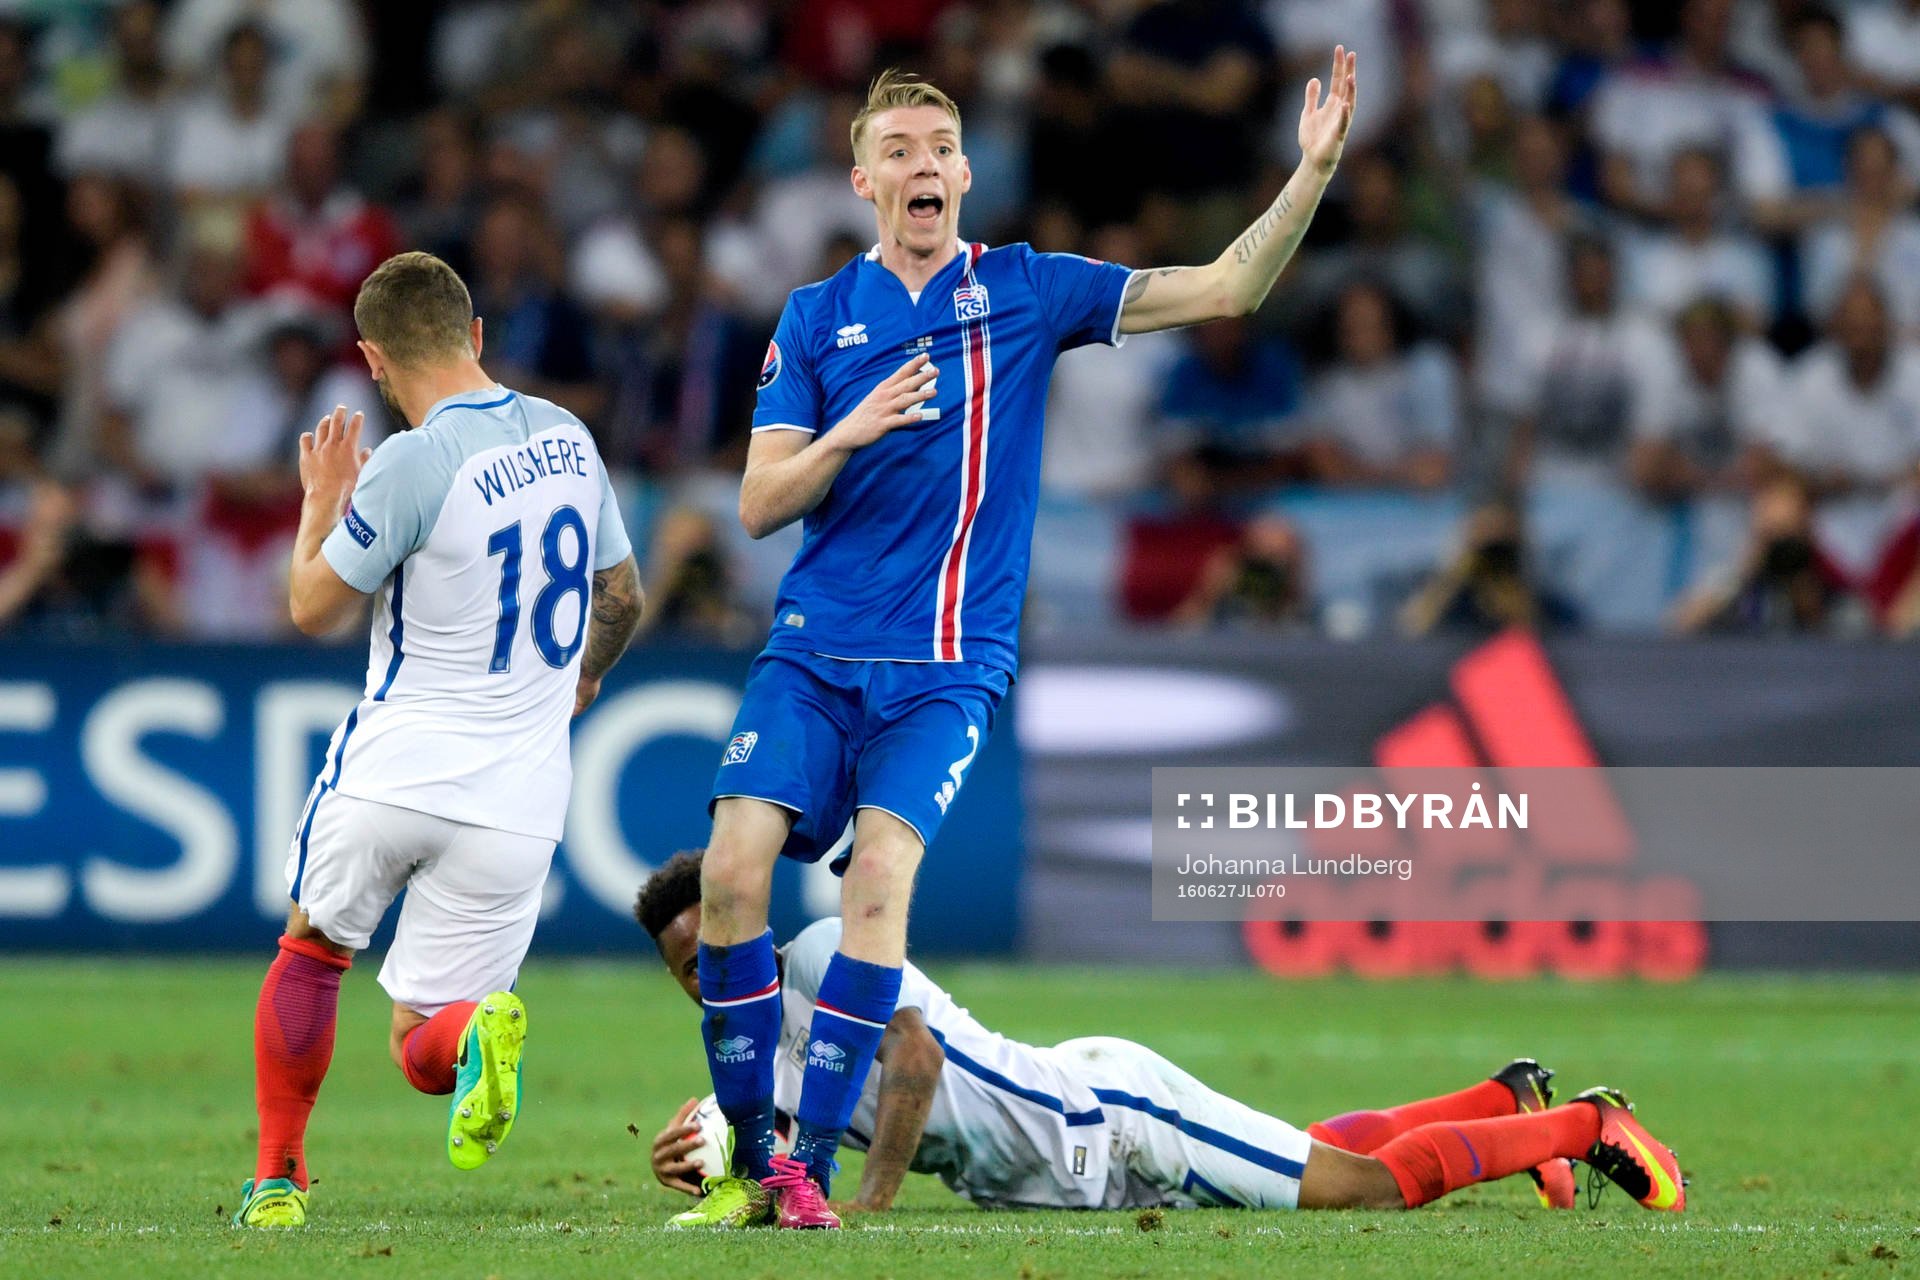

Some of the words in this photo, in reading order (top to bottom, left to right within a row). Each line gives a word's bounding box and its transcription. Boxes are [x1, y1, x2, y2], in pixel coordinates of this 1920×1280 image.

[474, 438, 587, 506] WILSHERE
[487, 504, 589, 675] 18
[948, 725, 979, 792] 2
